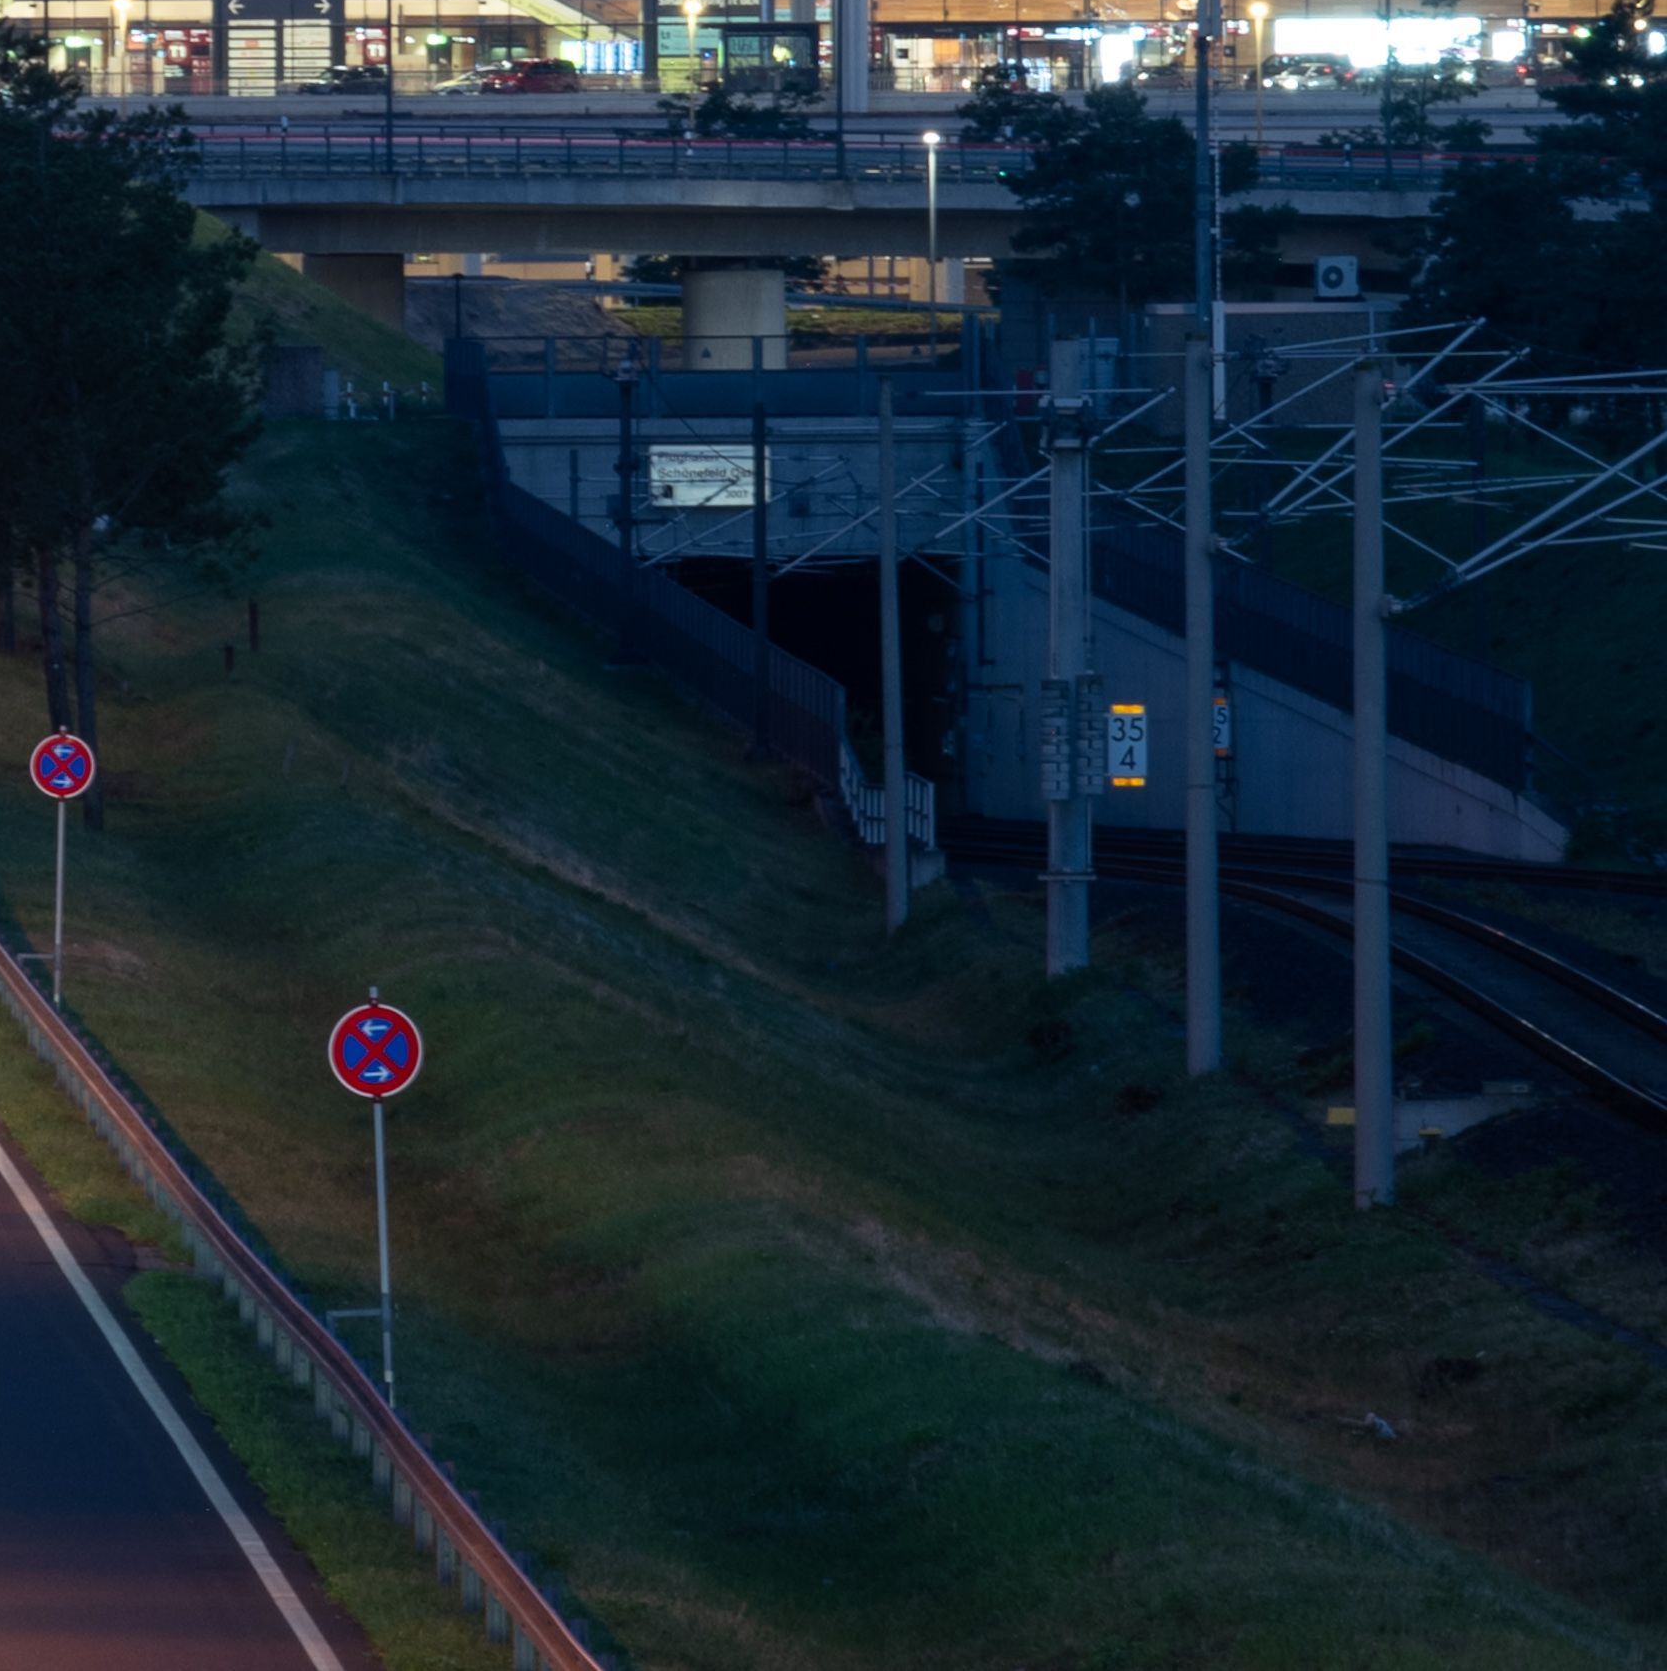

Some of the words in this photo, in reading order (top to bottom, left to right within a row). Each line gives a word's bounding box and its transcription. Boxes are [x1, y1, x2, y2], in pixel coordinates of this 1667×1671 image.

[658, 467, 727, 479] Schönefeld
[1110, 717, 1144, 743] 35
[1118, 745, 1137, 771] 4
